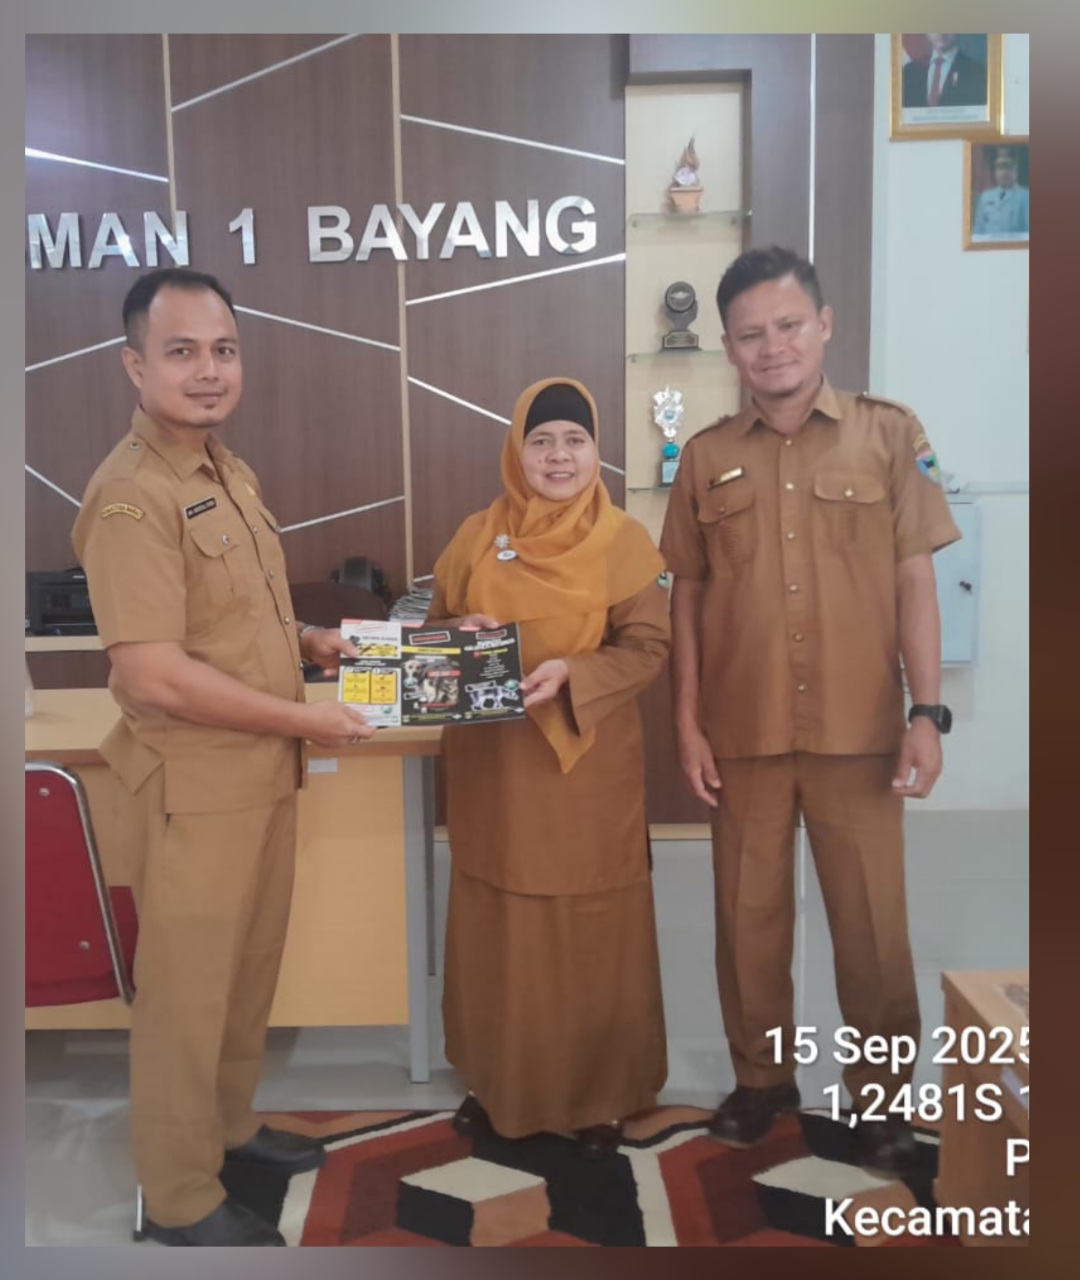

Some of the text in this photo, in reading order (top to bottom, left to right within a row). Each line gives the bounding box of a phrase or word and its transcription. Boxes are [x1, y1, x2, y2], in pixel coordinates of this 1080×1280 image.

[27, 195, 598, 269] MAN 1 BAYANG
